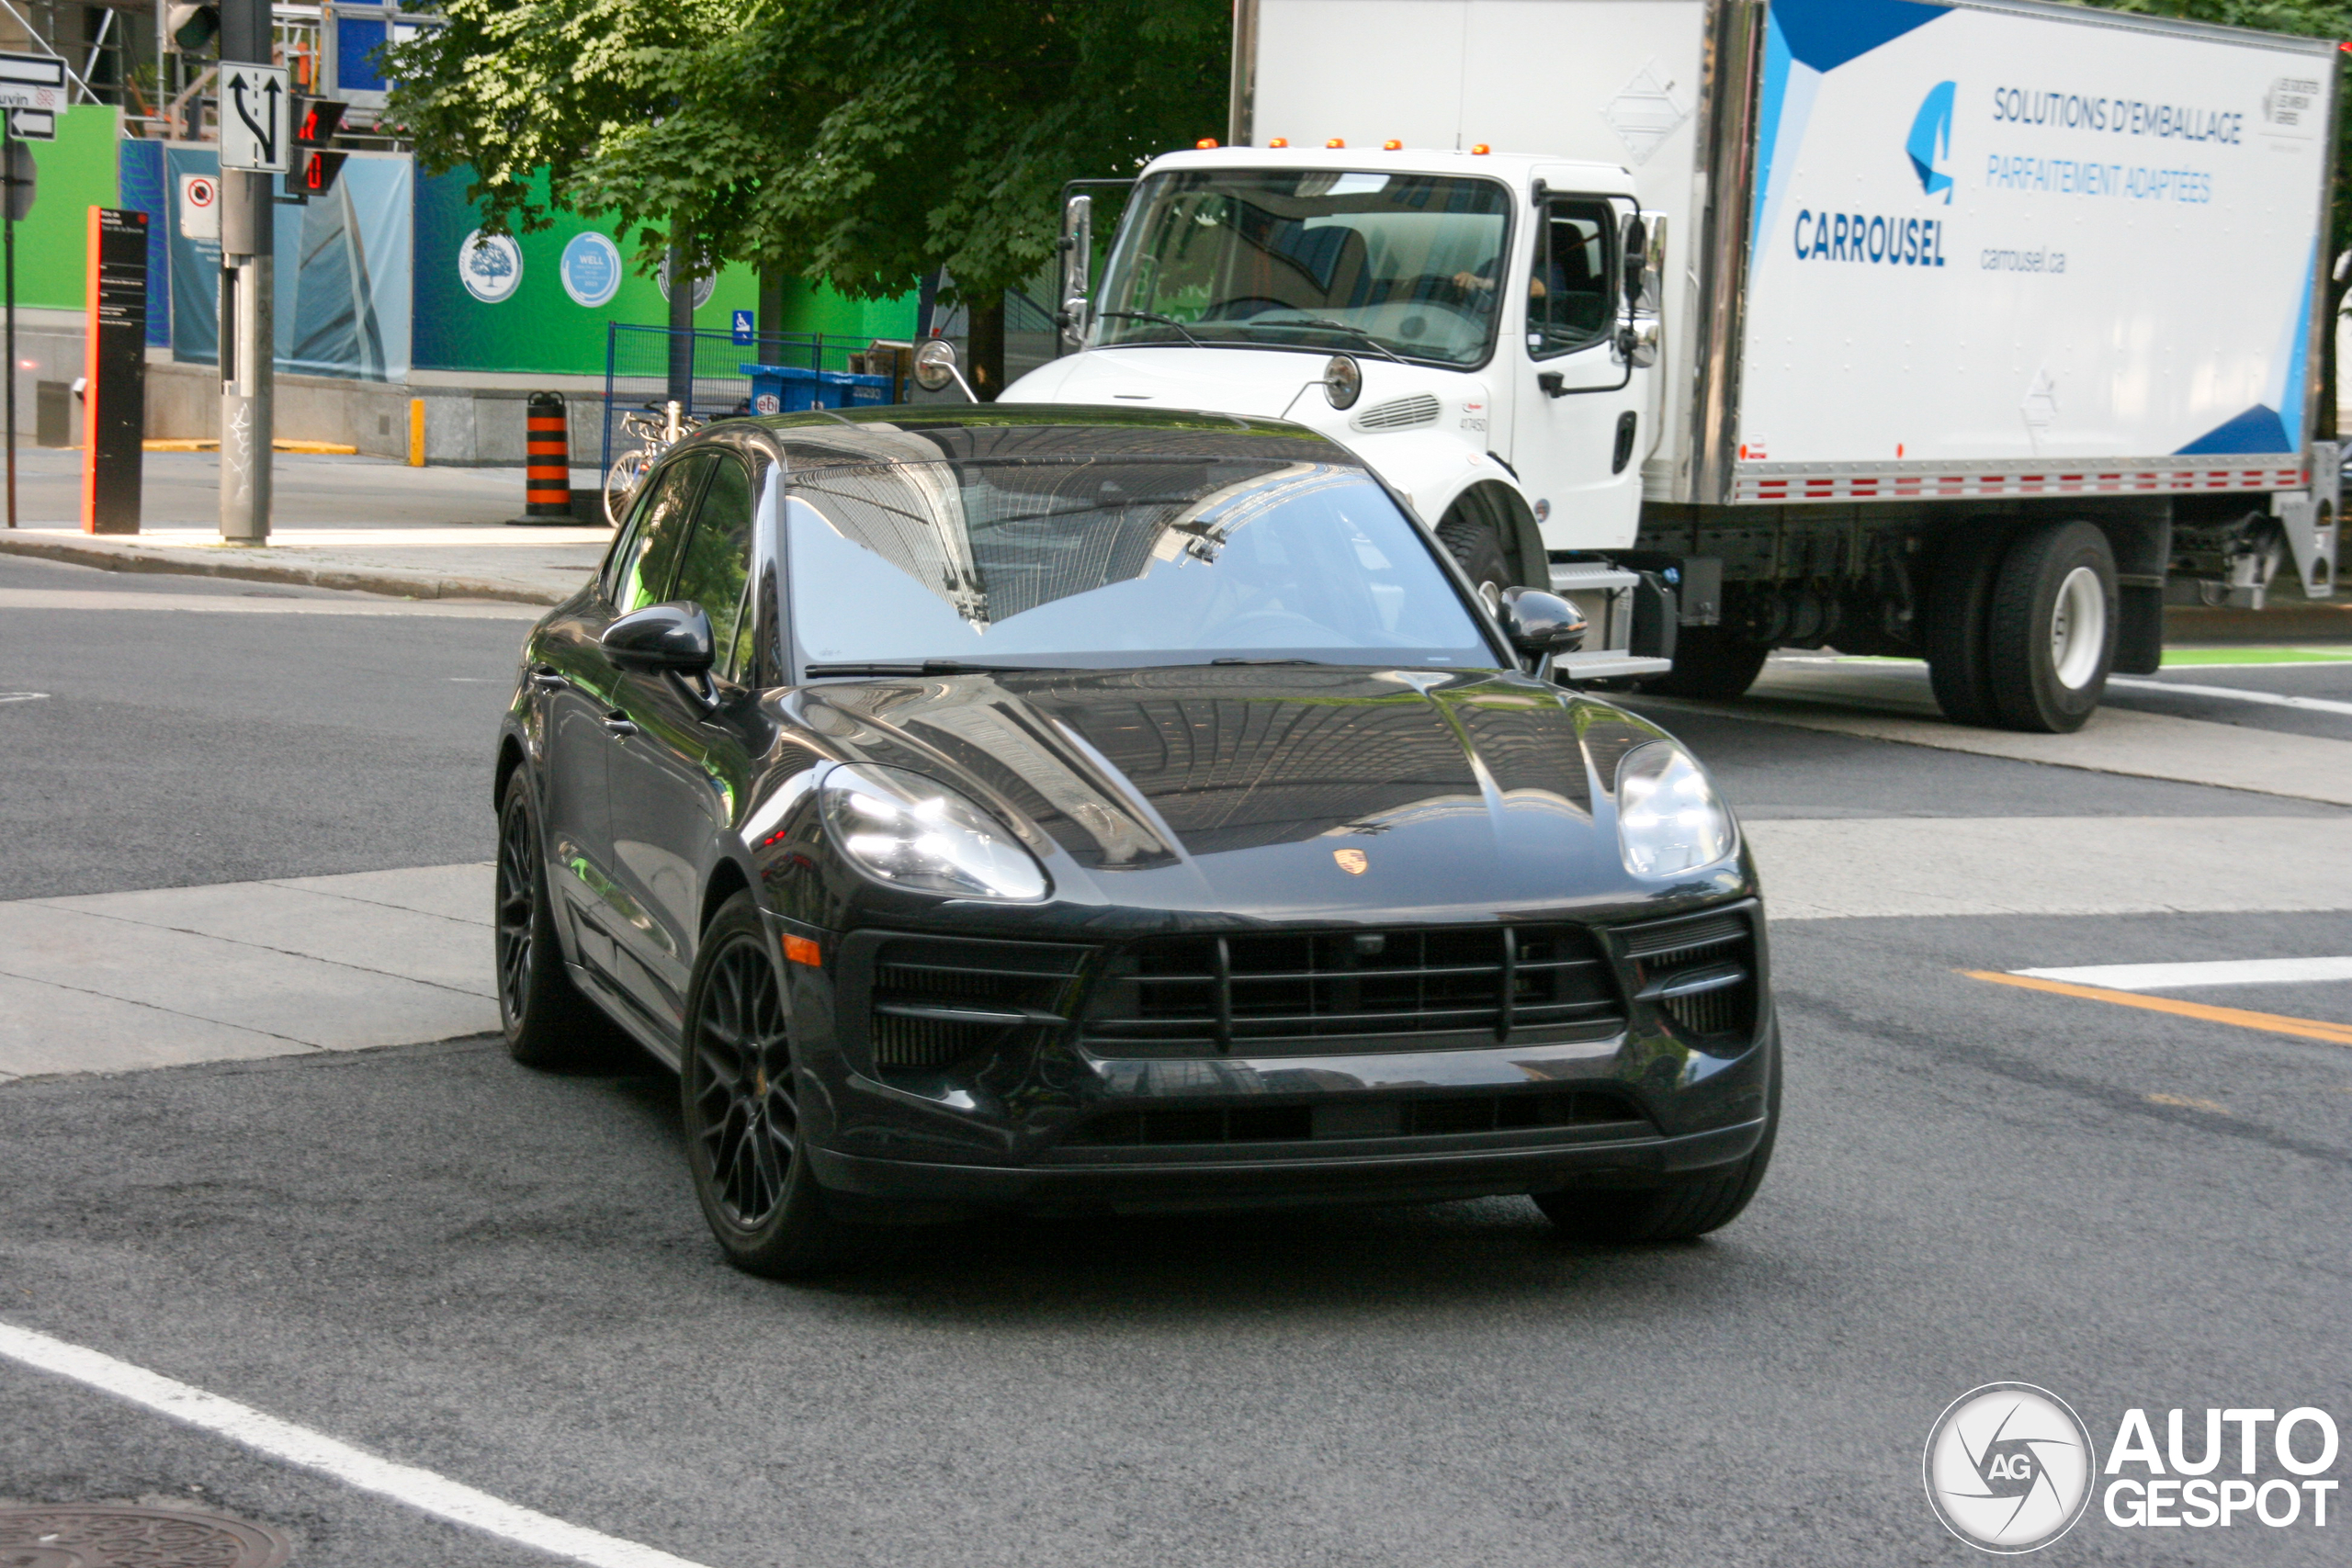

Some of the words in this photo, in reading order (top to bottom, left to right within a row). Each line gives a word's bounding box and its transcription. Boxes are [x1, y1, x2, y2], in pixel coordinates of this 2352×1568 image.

[1993, 86, 2107, 130] SOLUTIONS
[2112, 99, 2243, 144] D'EMBALLAGE
[1986, 153, 2121, 196] PARFAITEMENT
[2123, 164, 2211, 204] ADAPTÉES
[580, 255, 604, 265] WELL
[1793, 209, 1945, 267] CARROUSEL
[1981, 245, 2065, 274] carrousel.ca
